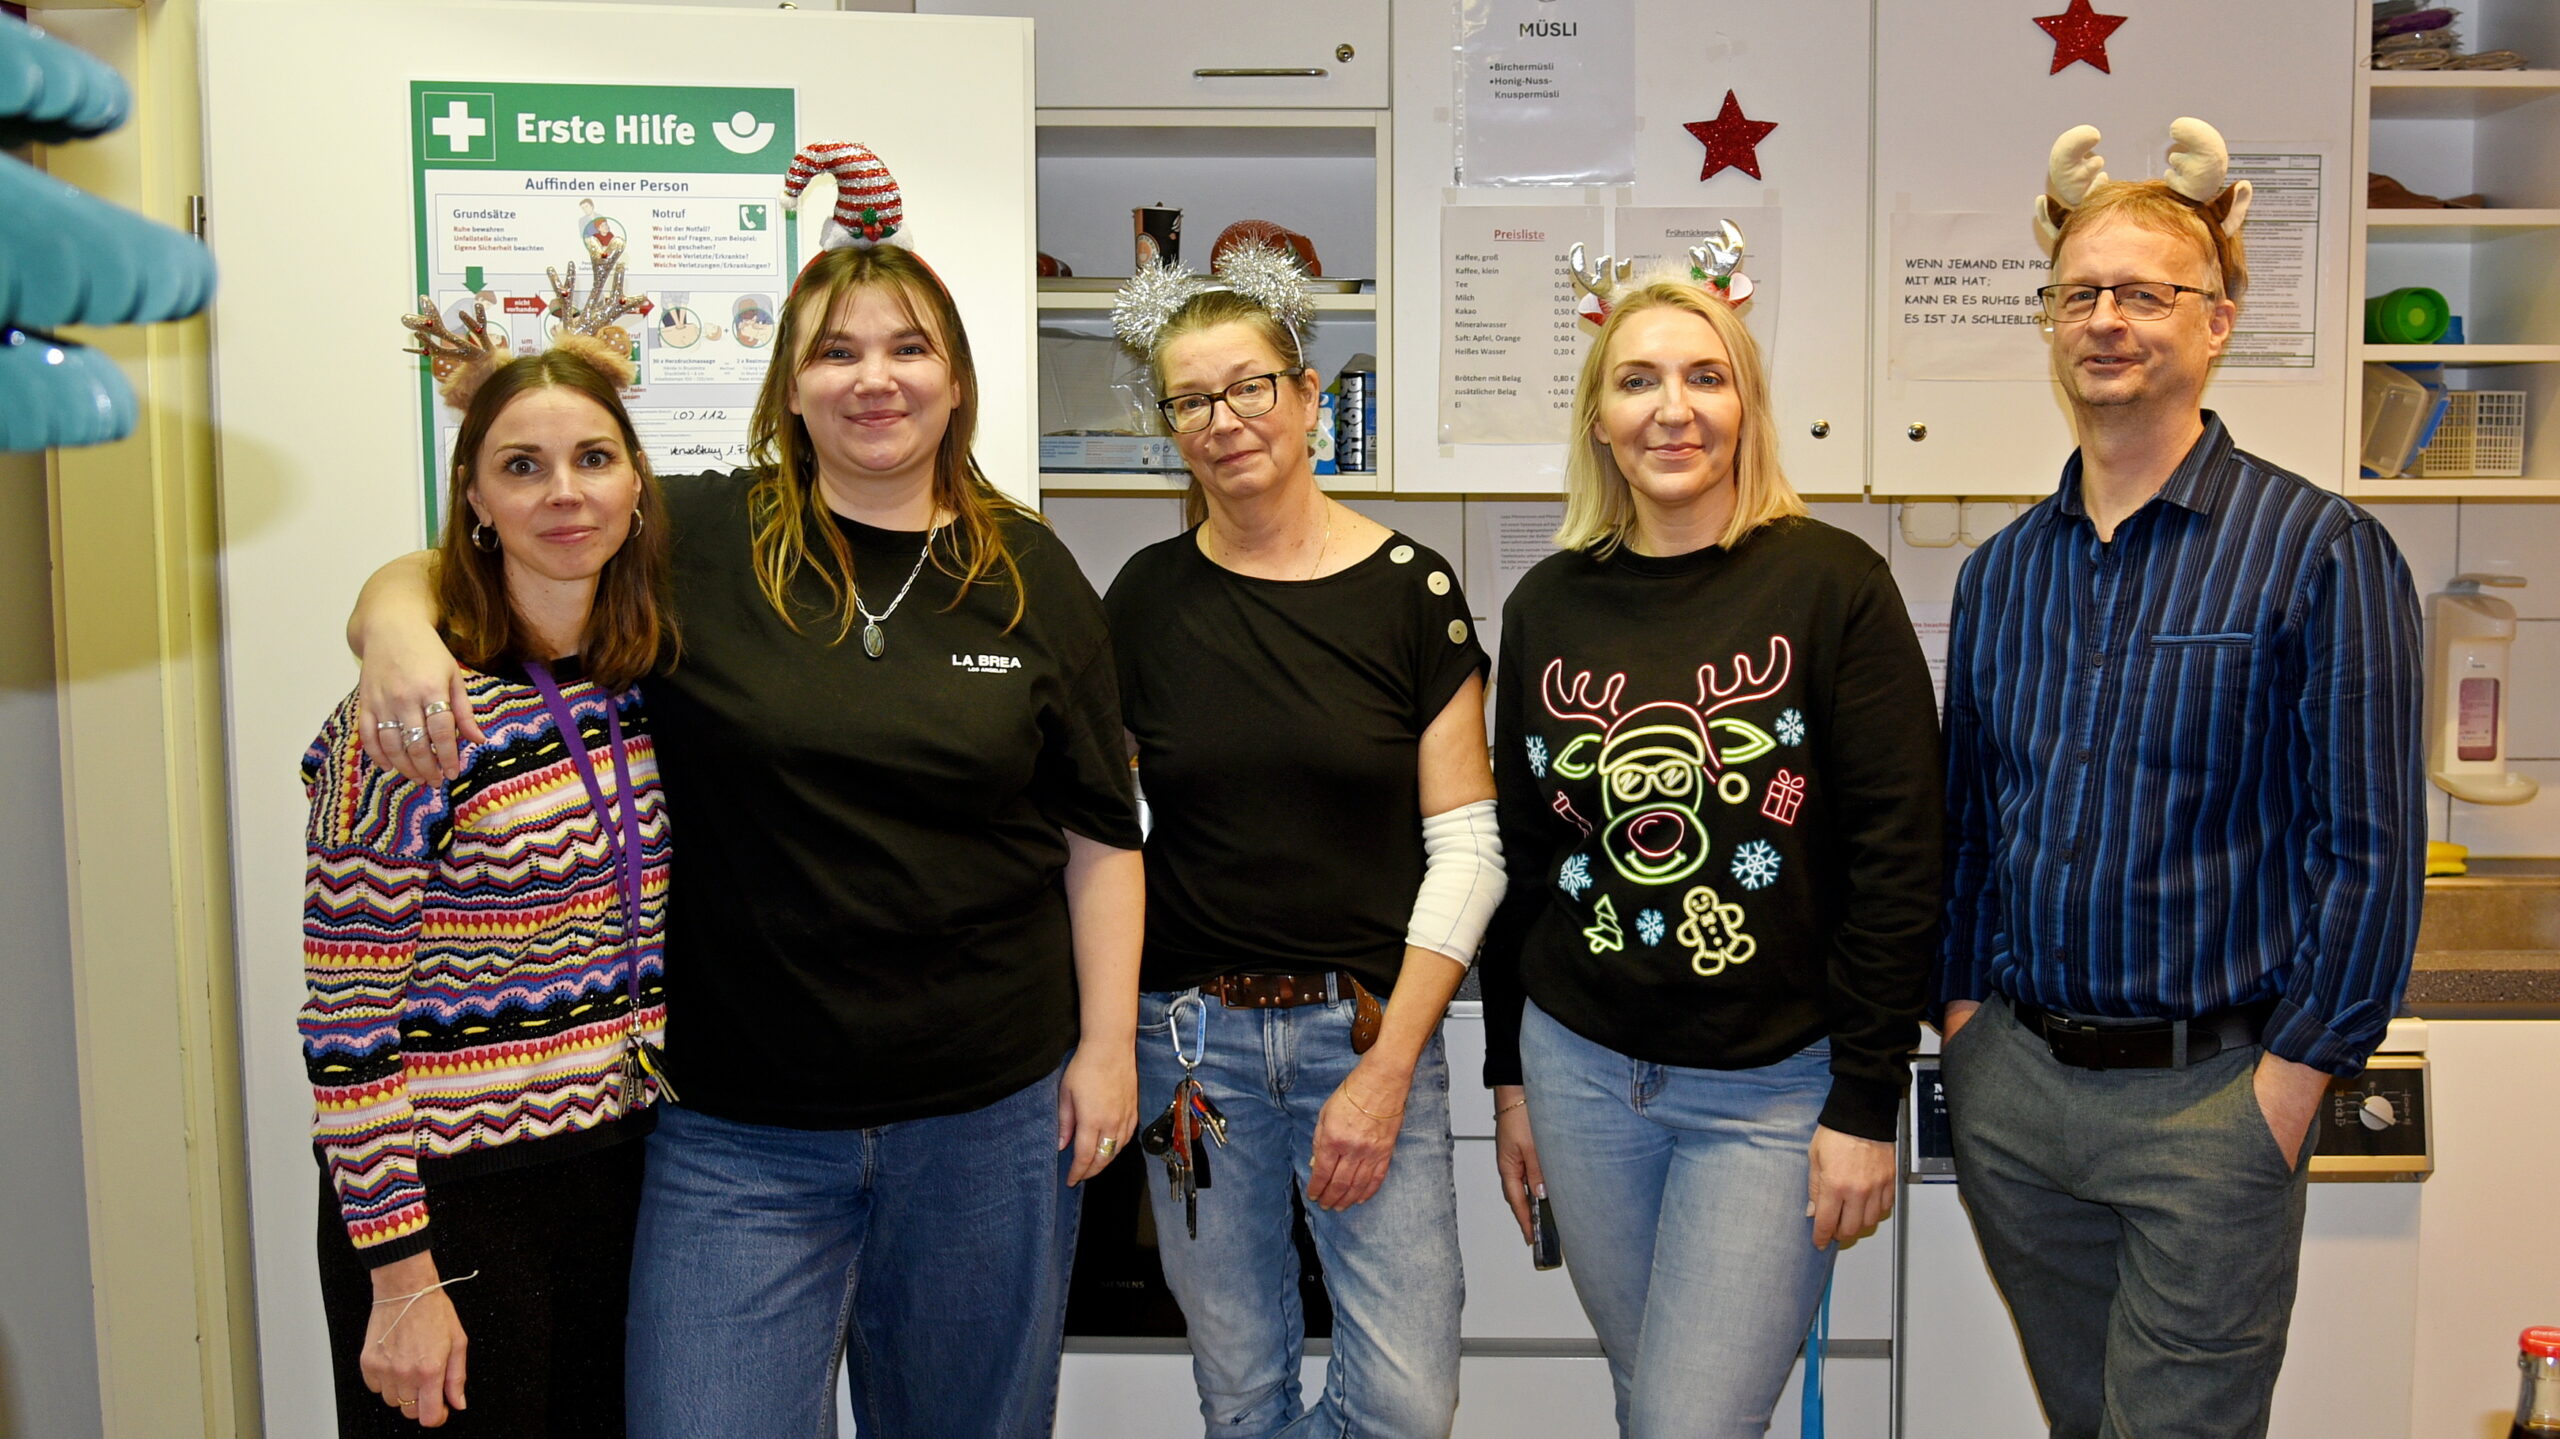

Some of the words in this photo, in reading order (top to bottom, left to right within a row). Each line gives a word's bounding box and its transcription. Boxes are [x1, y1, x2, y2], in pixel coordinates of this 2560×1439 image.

[1520, 20, 1577, 36] MÜSLI
[1494, 62, 1554, 71] Birchermüsli
[1494, 77, 1552, 87] Honig-Nuss-
[1495, 90, 1559, 100] Knuspermüsli
[517, 113, 605, 144] Erste
[616, 114, 695, 145] Hilfe
[525, 178, 594, 190] Auffinden
[600, 179, 636, 190] einer
[640, 180, 689, 191] Person
[453, 209, 516, 219] Grundsätze
[652, 209, 686, 218] Notruf
[1493, 229, 1545, 240] Preisliste
[1456, 254, 1480, 262] Kaffee,
[1482, 254, 1498, 263] groß
[1906, 259, 1943, 268] WENN
[1948, 259, 1997, 269] JEMAND
[2002, 260, 2024, 269] EIN
[1905, 276, 1928, 285] MIT
[1934, 276, 1956, 285] MIR
[1962, 277, 1991, 286] HAT;
[1905, 295, 1938, 304] KANN
[1943, 295, 1957, 304] ER
[1962, 295, 1977, 305] ES
[1982, 296, 2020, 305] RUHIG
[1904, 314, 1919, 324] ES
[1924, 314, 1946, 324] IST
[1951, 314, 1966, 324] JA
[1502, 375, 1521, 383] Belag
[1497, 389, 1516, 397] Belag
[700, 411, 726, 420] 112
[1340, 376, 1362, 465] STRONG
[952, 654, 974, 666] LA
[978, 655, 1021, 668] BREA
